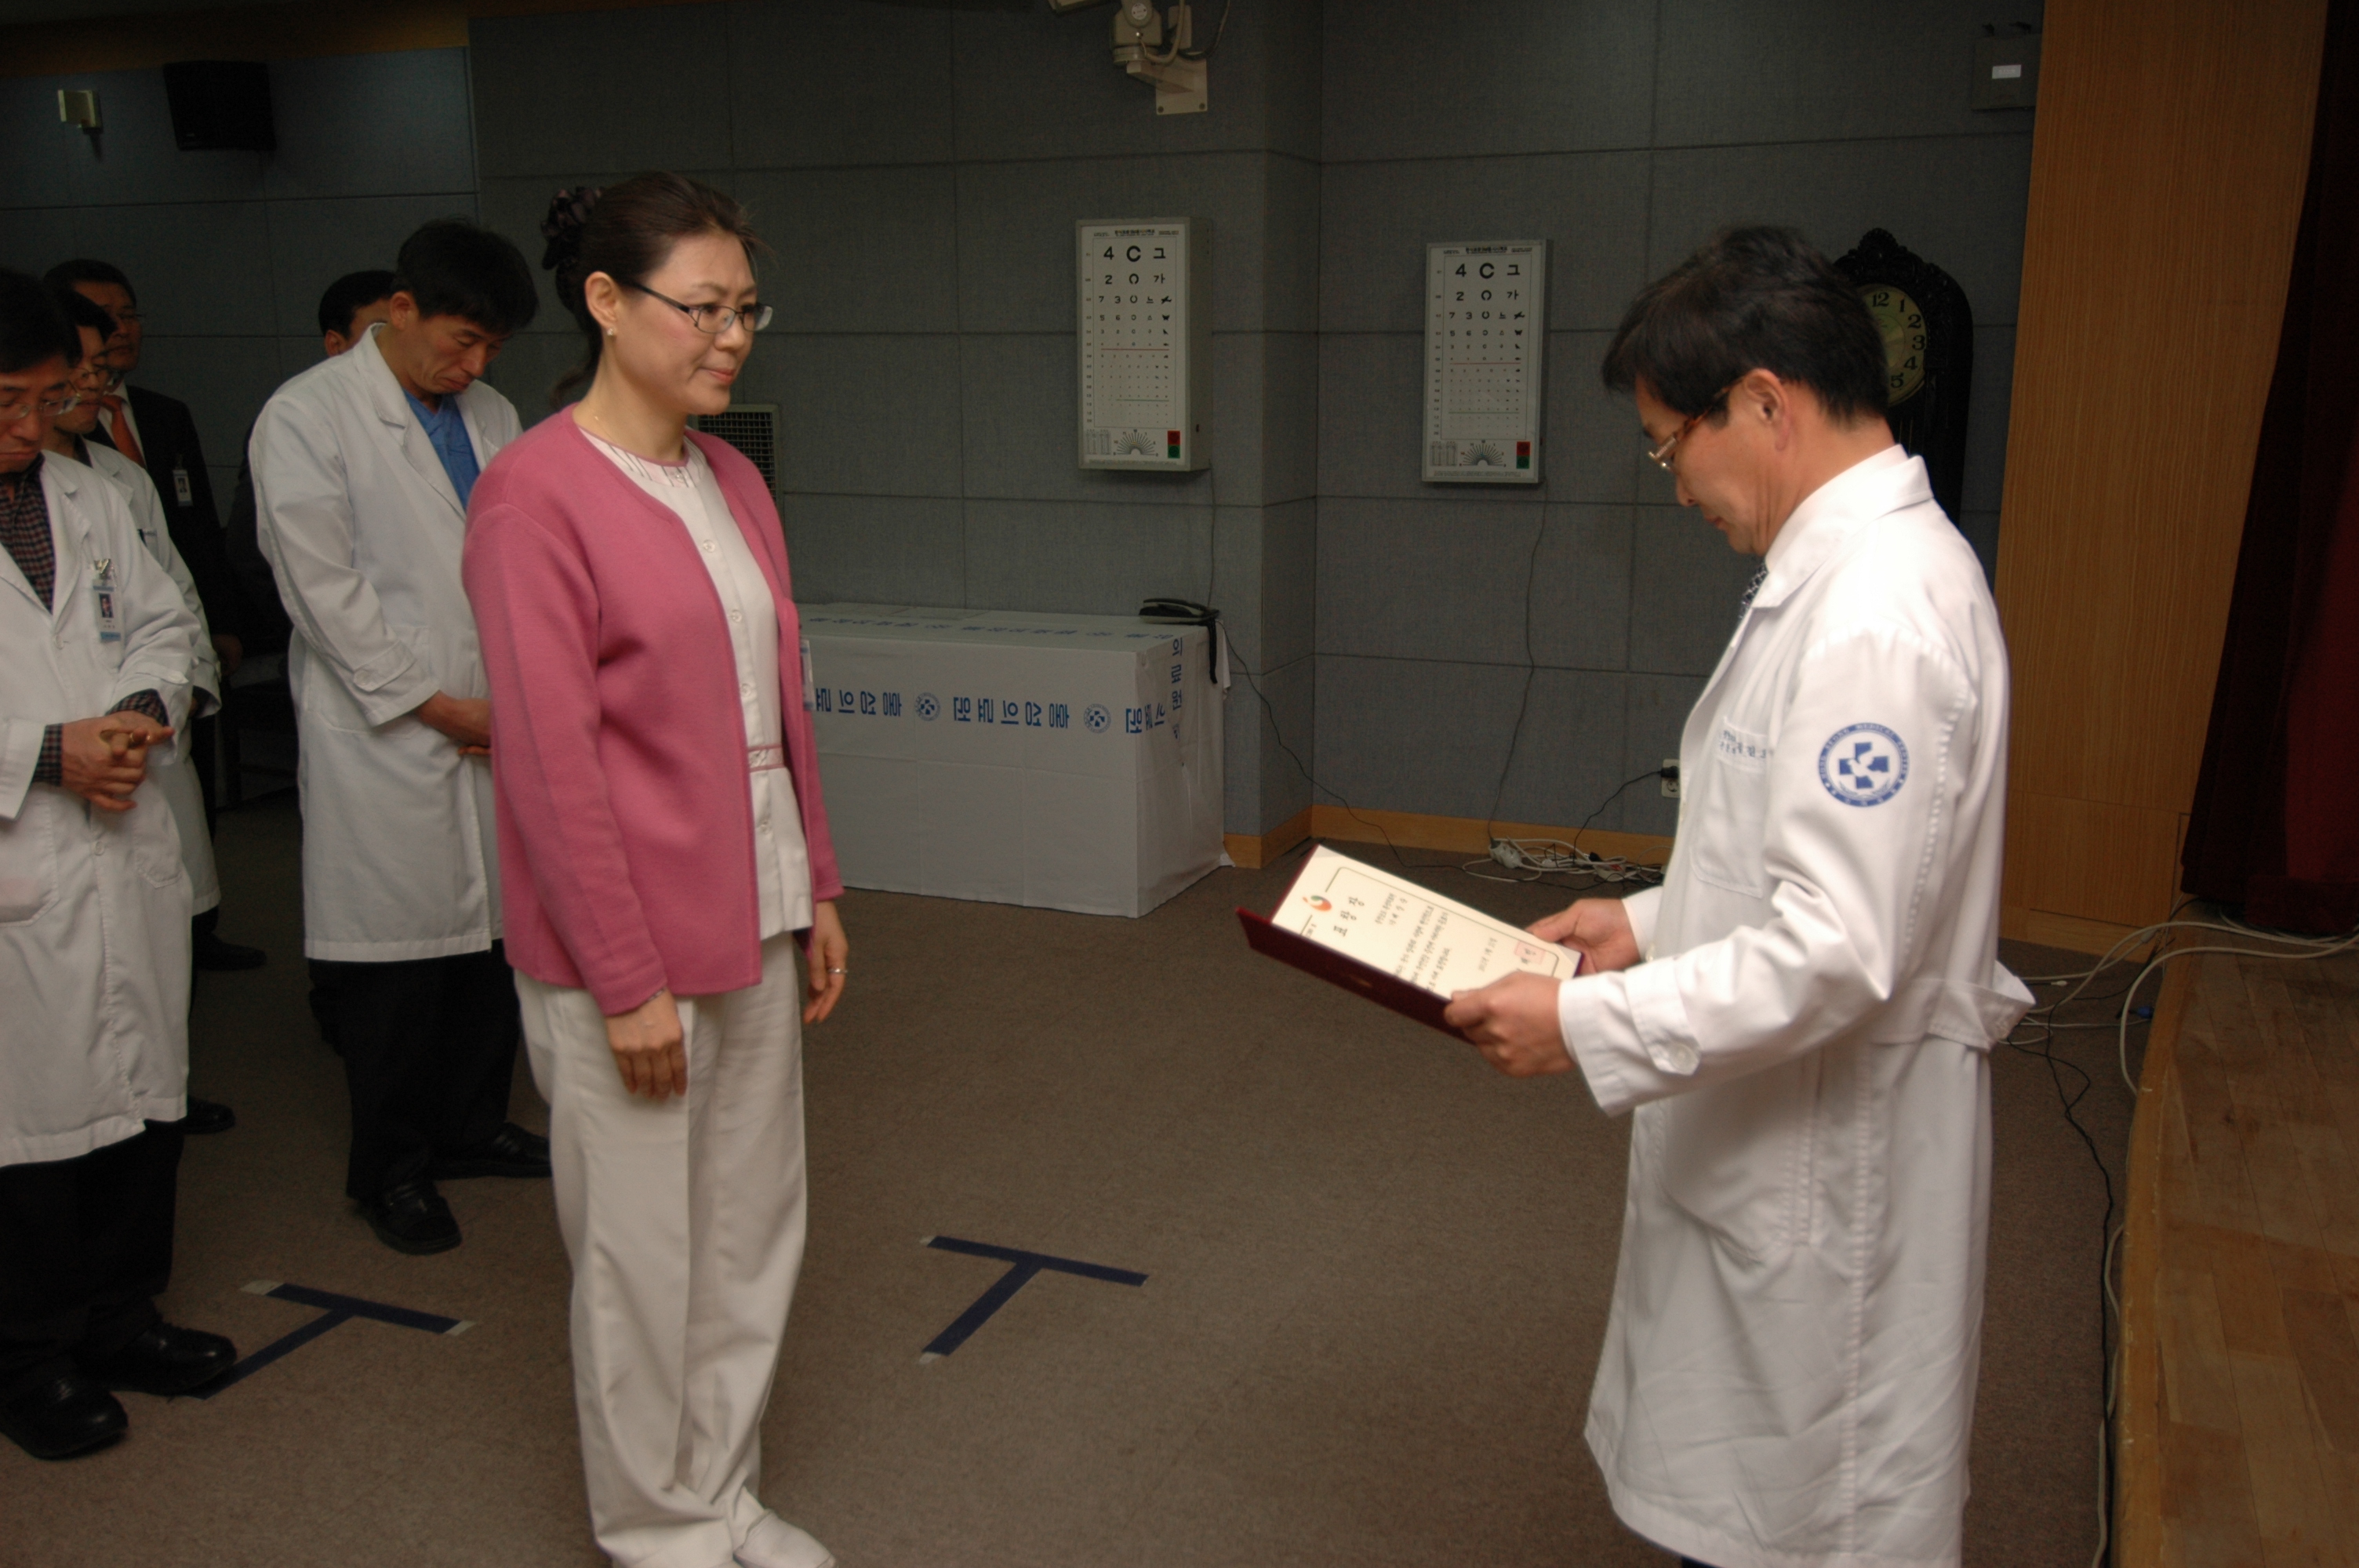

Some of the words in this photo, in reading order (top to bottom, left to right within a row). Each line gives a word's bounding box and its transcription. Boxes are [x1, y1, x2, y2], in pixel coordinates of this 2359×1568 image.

[1103, 245, 1114, 260] 4
[1455, 263, 1467, 278] 4
[1105, 274, 1113, 285] 2
[1153, 273, 1165, 284] 가
[1098, 295, 1105, 303] 7
[1114, 295, 1121, 304] 3
[1456, 291, 1465, 302] 2
[1507, 289, 1519, 300] 가
[1872, 292, 1889, 307] 12
[1899, 299, 1905, 312] 1
[1465, 311, 1473, 320] 3
[1907, 314, 1921, 328] 2
[1912, 336, 1925, 350] 3
[1904, 356, 1918, 370] 4
[1891, 372, 1904, 388] 5
[816, 688, 902, 717] 홍성의료
[953, 696, 1070, 729] 홍성의료원
